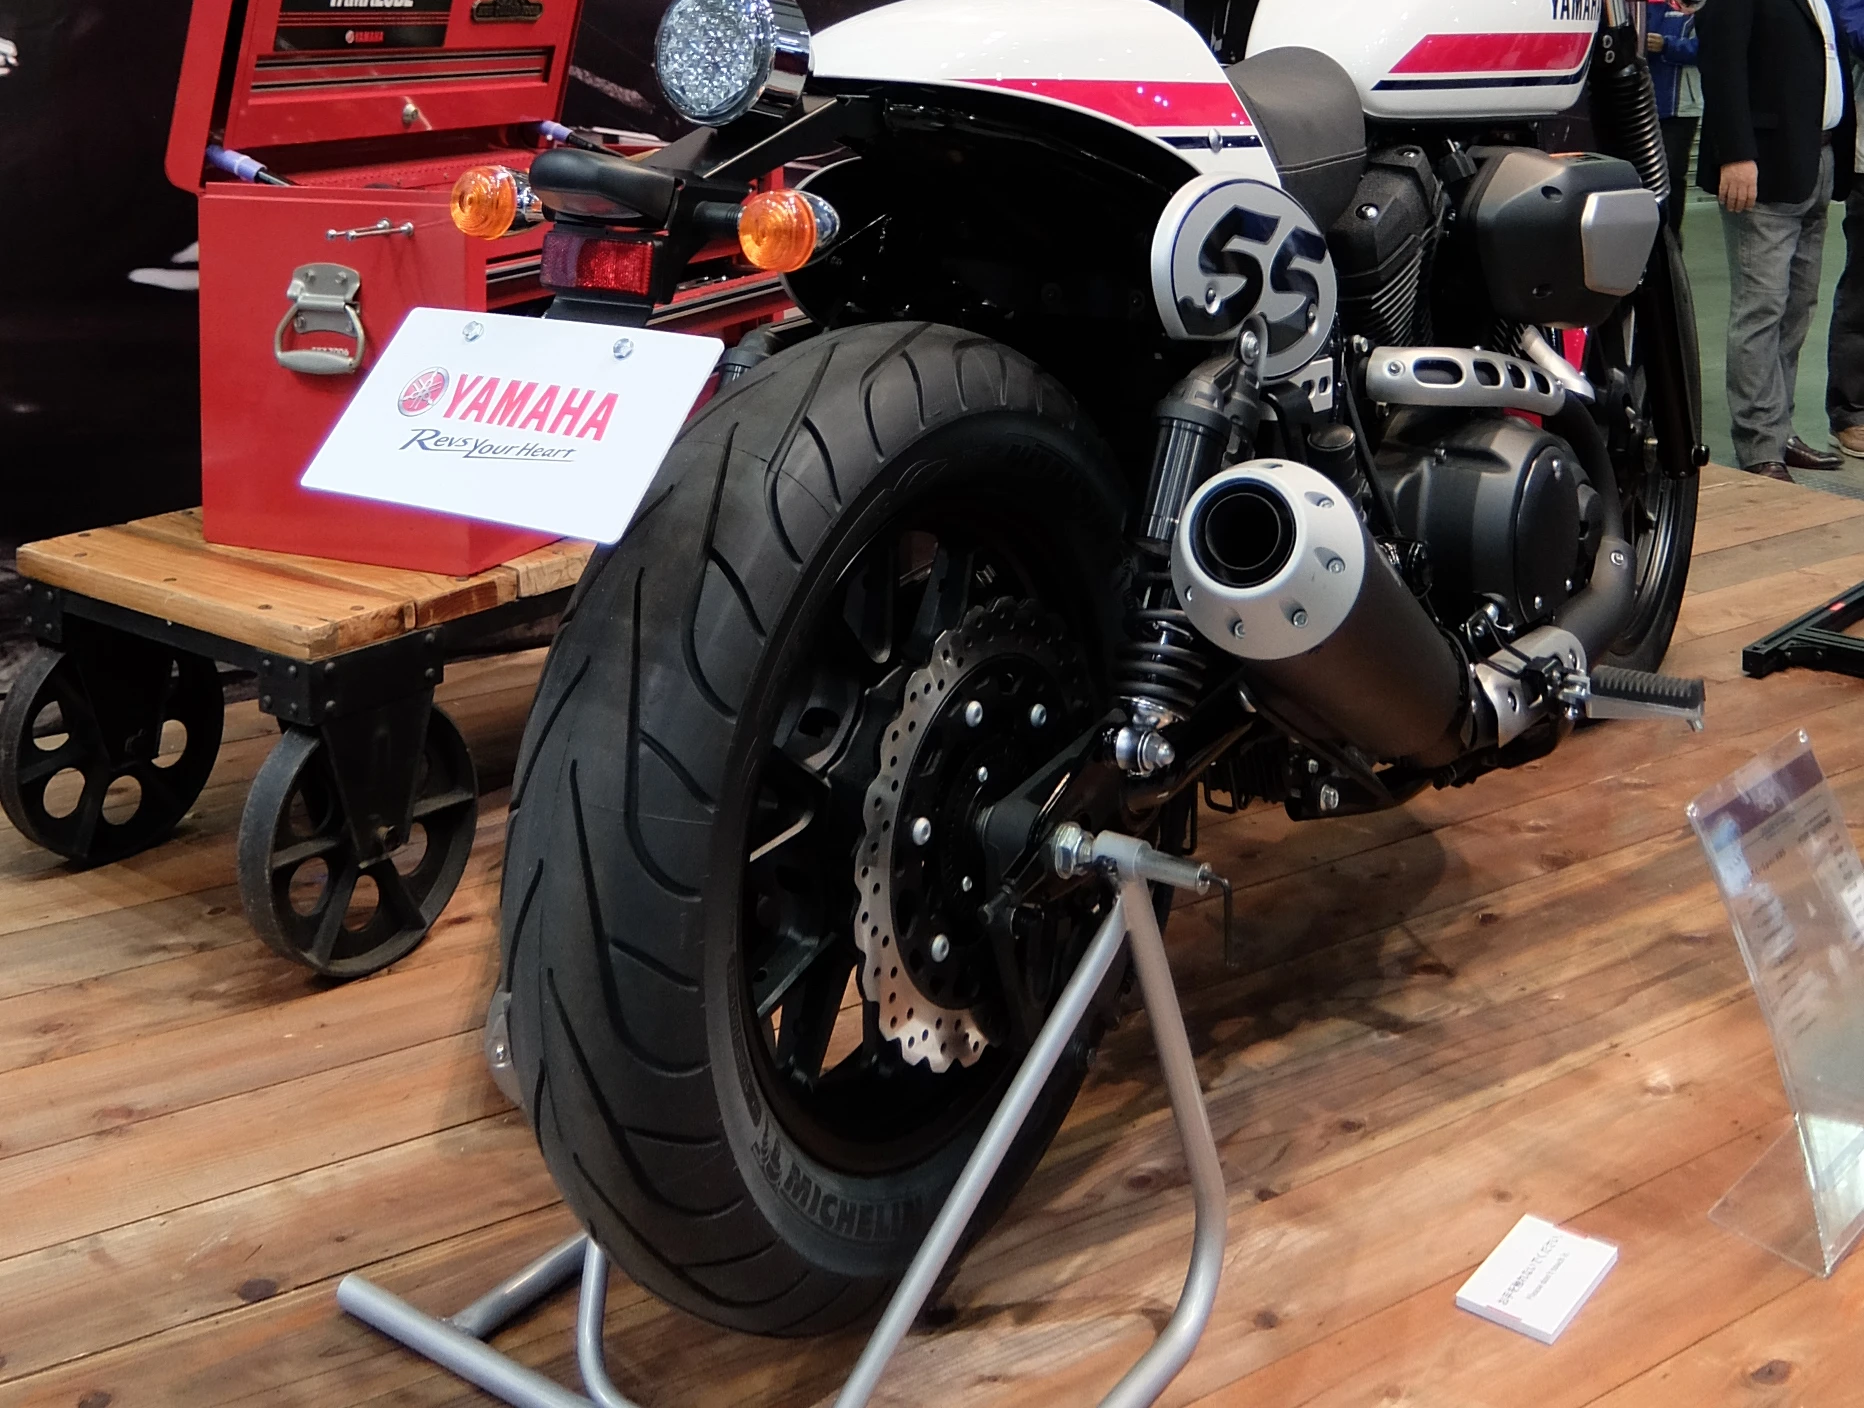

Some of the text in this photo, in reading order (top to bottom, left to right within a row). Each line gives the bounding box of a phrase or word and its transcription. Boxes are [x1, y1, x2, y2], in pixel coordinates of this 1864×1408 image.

[354, 31, 384, 42] YAMAHA
[1178, 204, 1328, 358] 55
[443, 373, 619, 442] YAMAHA
[398, 428, 577, 459] Revs Your Heart
[783, 1160, 925, 1242] MICHELIN
